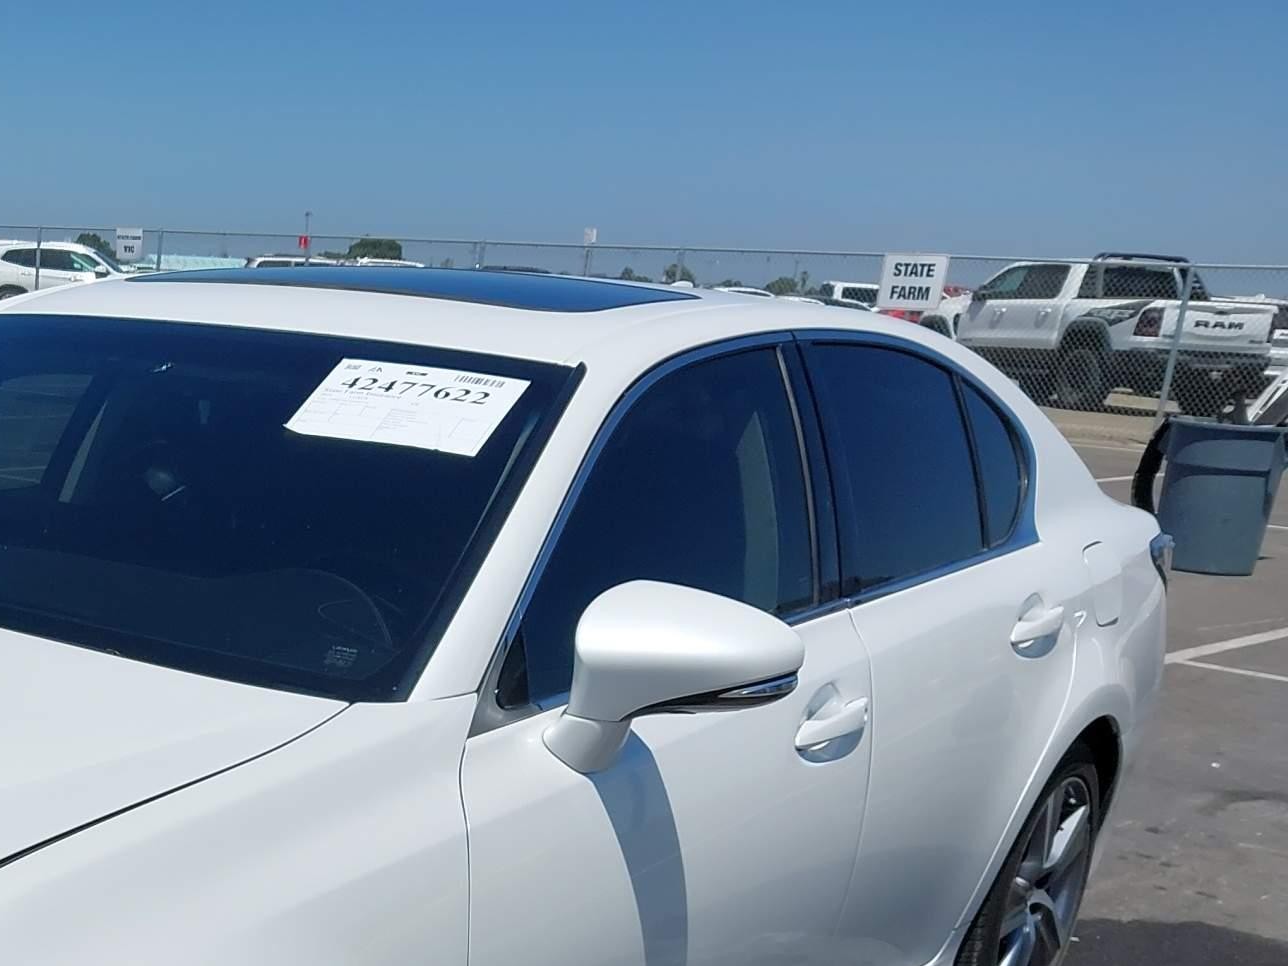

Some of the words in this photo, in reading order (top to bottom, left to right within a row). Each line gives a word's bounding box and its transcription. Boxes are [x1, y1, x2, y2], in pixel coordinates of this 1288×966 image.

[893, 262, 937, 278] STATE
[889, 284, 931, 301] FARM
[1193, 319, 1245, 331] RAM
[340, 376, 491, 405] 42477622
